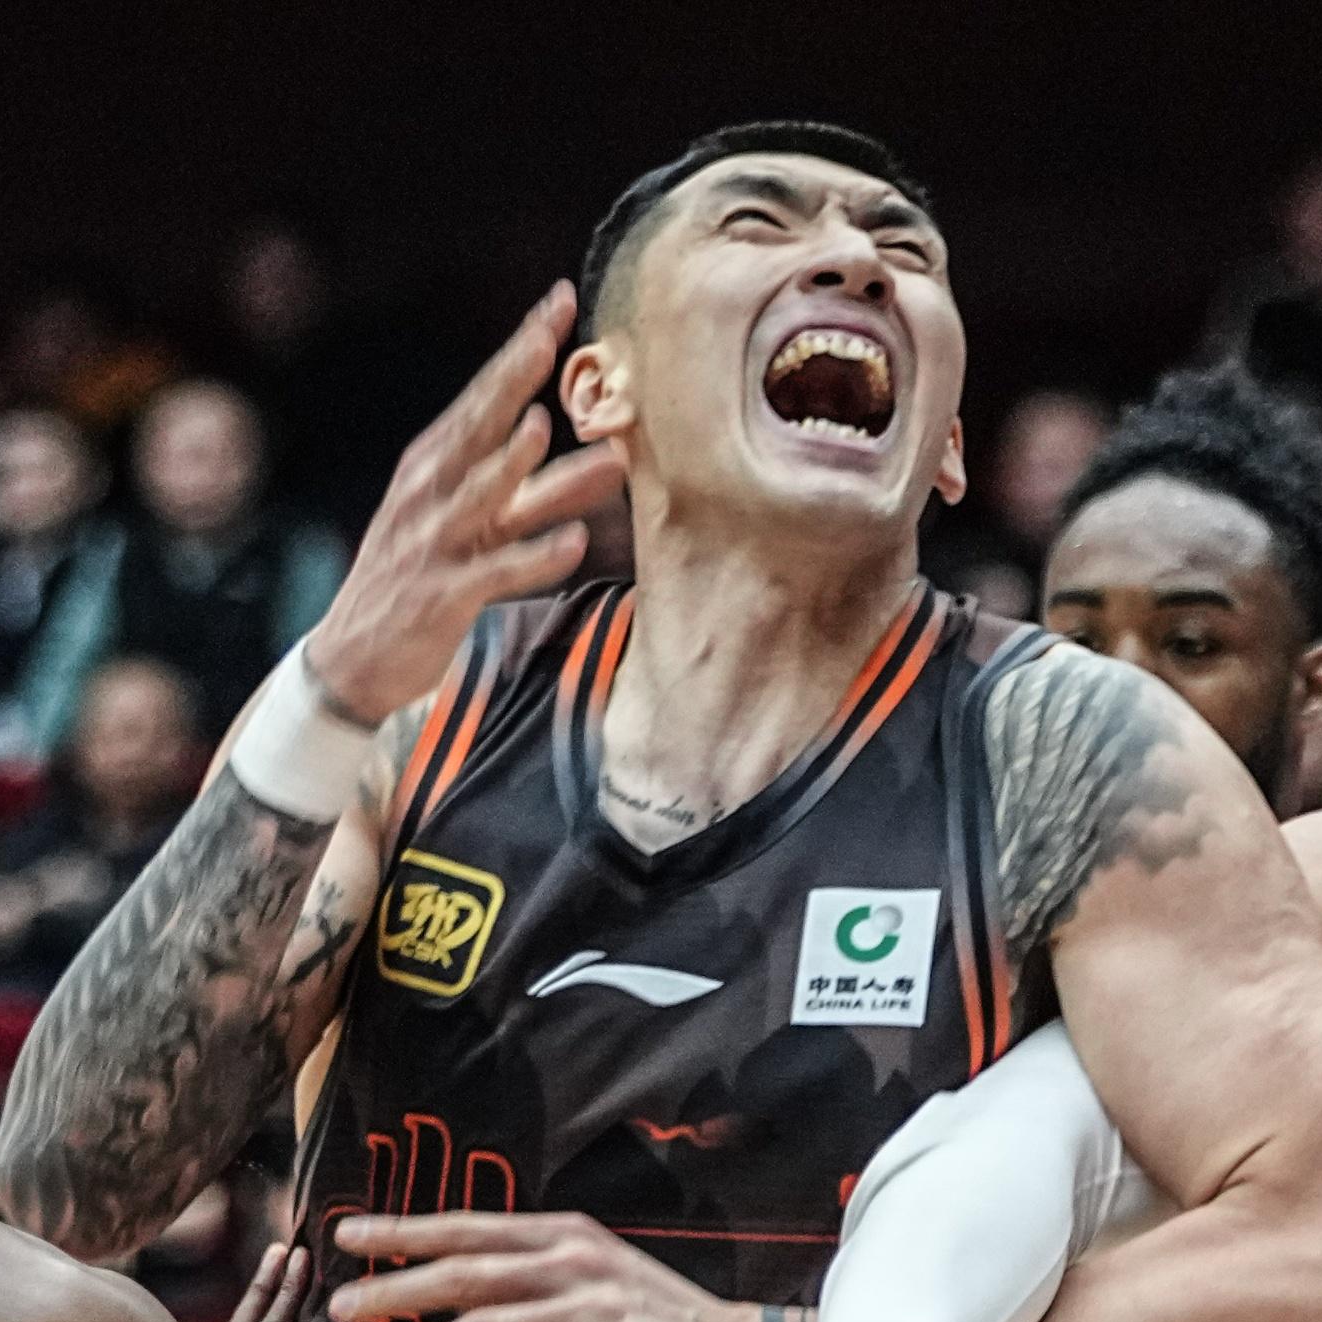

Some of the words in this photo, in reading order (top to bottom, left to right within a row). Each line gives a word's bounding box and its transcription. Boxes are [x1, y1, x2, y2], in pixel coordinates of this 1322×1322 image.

[808, 974, 915, 996] 中国人寿
[805, 998, 864, 1011] CHINA
[870, 999, 911, 1011] LIFE
